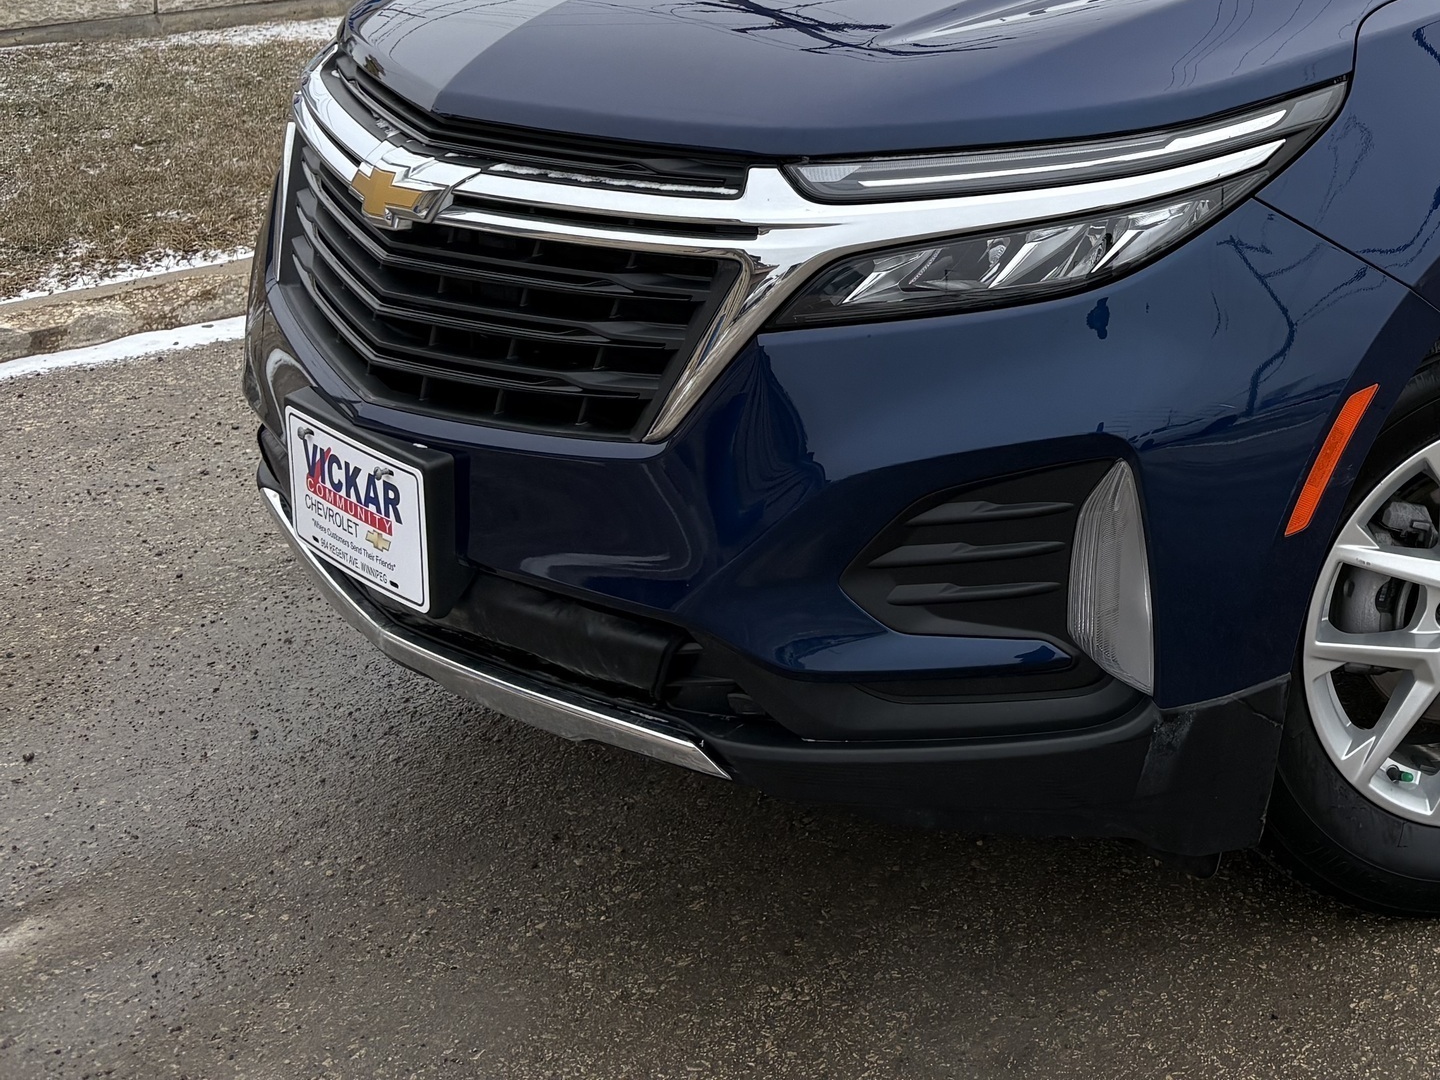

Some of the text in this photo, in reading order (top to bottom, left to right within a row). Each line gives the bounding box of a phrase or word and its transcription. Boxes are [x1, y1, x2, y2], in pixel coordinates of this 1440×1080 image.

[302, 438, 403, 525] VICKAR
[304, 493, 359, 538] CHEVROLET
[307, 477, 391, 533] COMMUNITY
[327, 528, 350, 548] Customers
[350, 541, 362, 556] Send
[363, 549, 375, 561] Their
[360, 561, 388, 584] WINNIPEG
